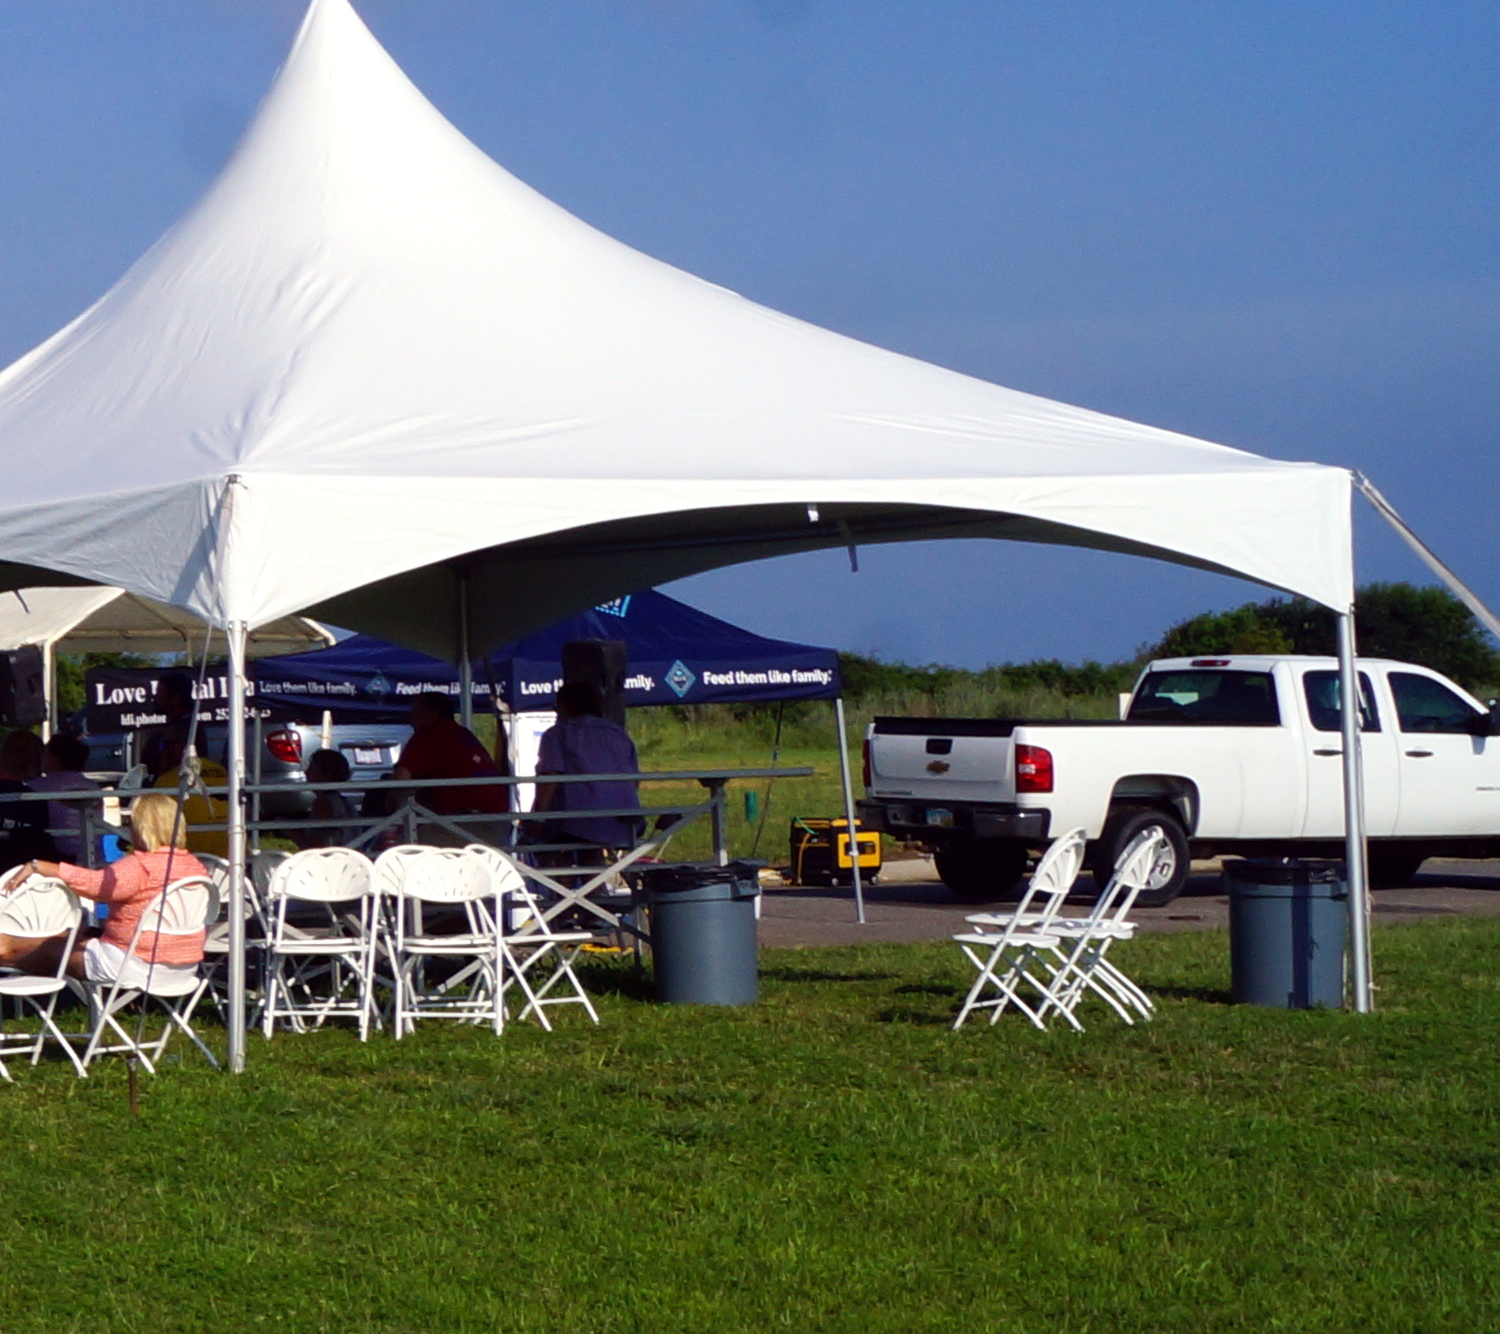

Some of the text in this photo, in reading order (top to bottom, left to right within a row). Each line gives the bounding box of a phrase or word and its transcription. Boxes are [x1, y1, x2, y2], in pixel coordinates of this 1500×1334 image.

[703, 671, 734, 686] Feed
[735, 670, 766, 684] them
[768, 669, 791, 684] like
[259, 681, 281, 693] Love
[283, 681, 306, 693] them
[308, 682, 325, 693] like
[396, 682, 421, 695] Feed
[521, 681, 552, 694] Love
[96, 684, 147, 705] Love
